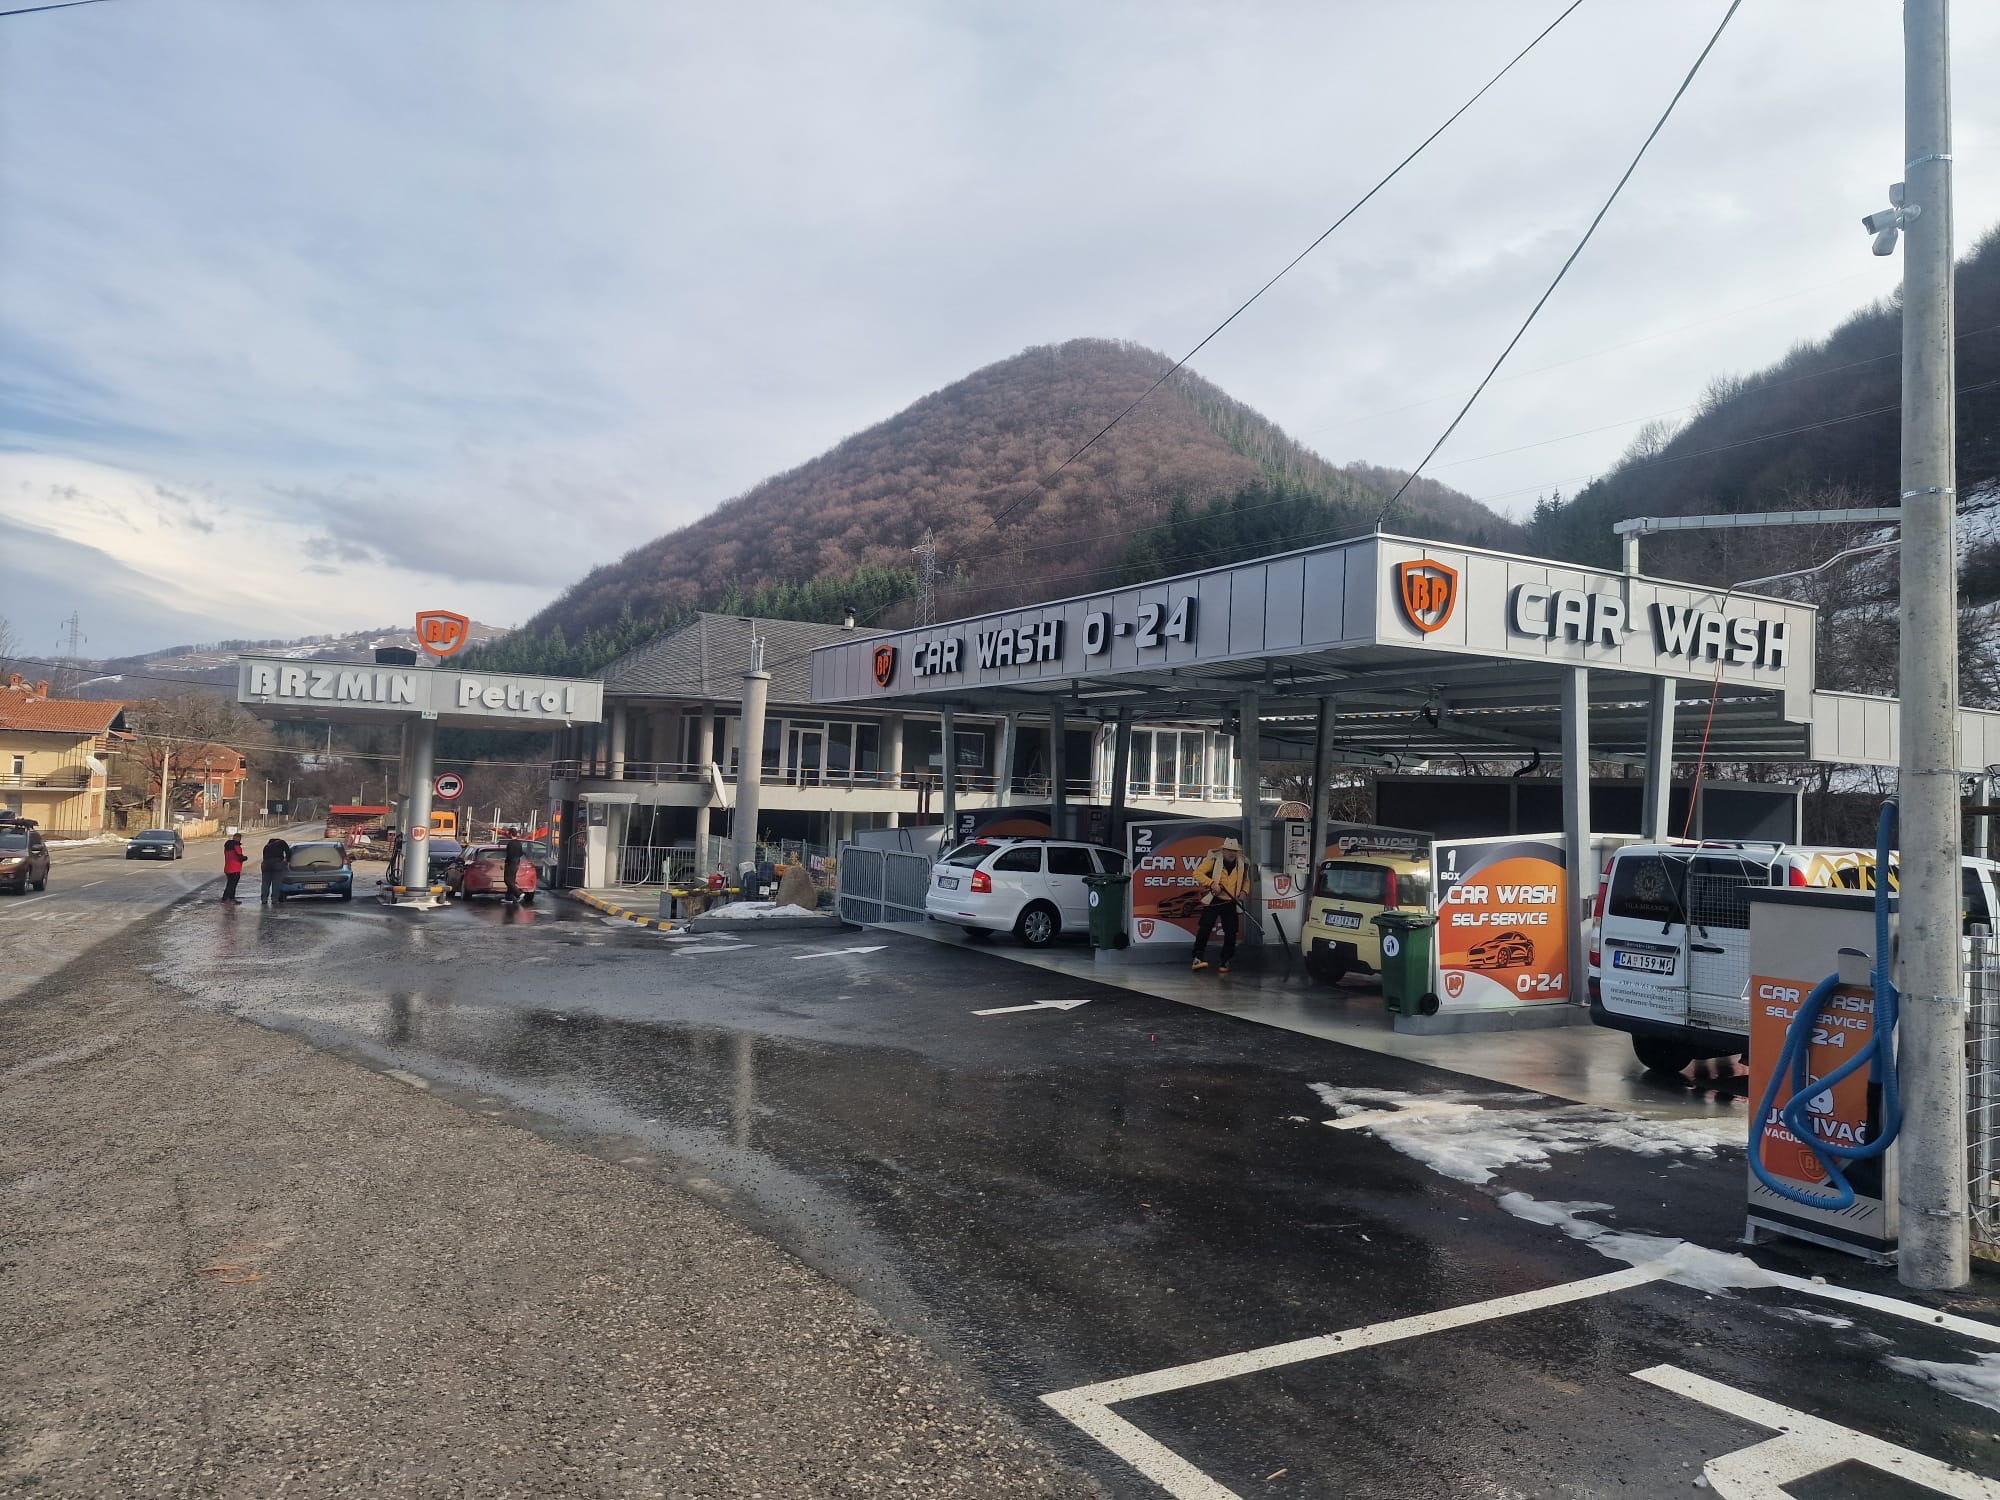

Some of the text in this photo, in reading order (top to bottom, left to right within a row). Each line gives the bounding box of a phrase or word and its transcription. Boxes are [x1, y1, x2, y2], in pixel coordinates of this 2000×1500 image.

[1410, 574, 1448, 613] BP
[426, 619, 460, 644] BP
[1513, 582, 1792, 668] CAR WASH
[911, 638, 960, 677] CAR
[975, 620, 1061, 669] WASH
[876, 654, 888, 677] BP
[250, 665, 576, 714] BRZMIN Petrol
[961, 815, 976, 829] 3
[413, 828, 425, 838] BP
[1137, 829, 1153, 846] 2
[1140, 856, 1176, 871] CAR
[1447, 849, 1457, 872] 1
[1144, 876, 1176, 887] SELF
[1277, 878, 1289, 890] BP
[1440, 872, 1460, 881] BOX
[1447, 884, 1557, 905] CAR WASH
[1451, 912, 1548, 927] SELF SERVICE
[1139, 923, 1153, 935] BP
[1448, 976, 1462, 991] BP
[1516, 973, 1564, 993] 0-24
[1759, 984, 1800, 1003] CAR
[1815, 1014, 1867, 1031] ERVICE
